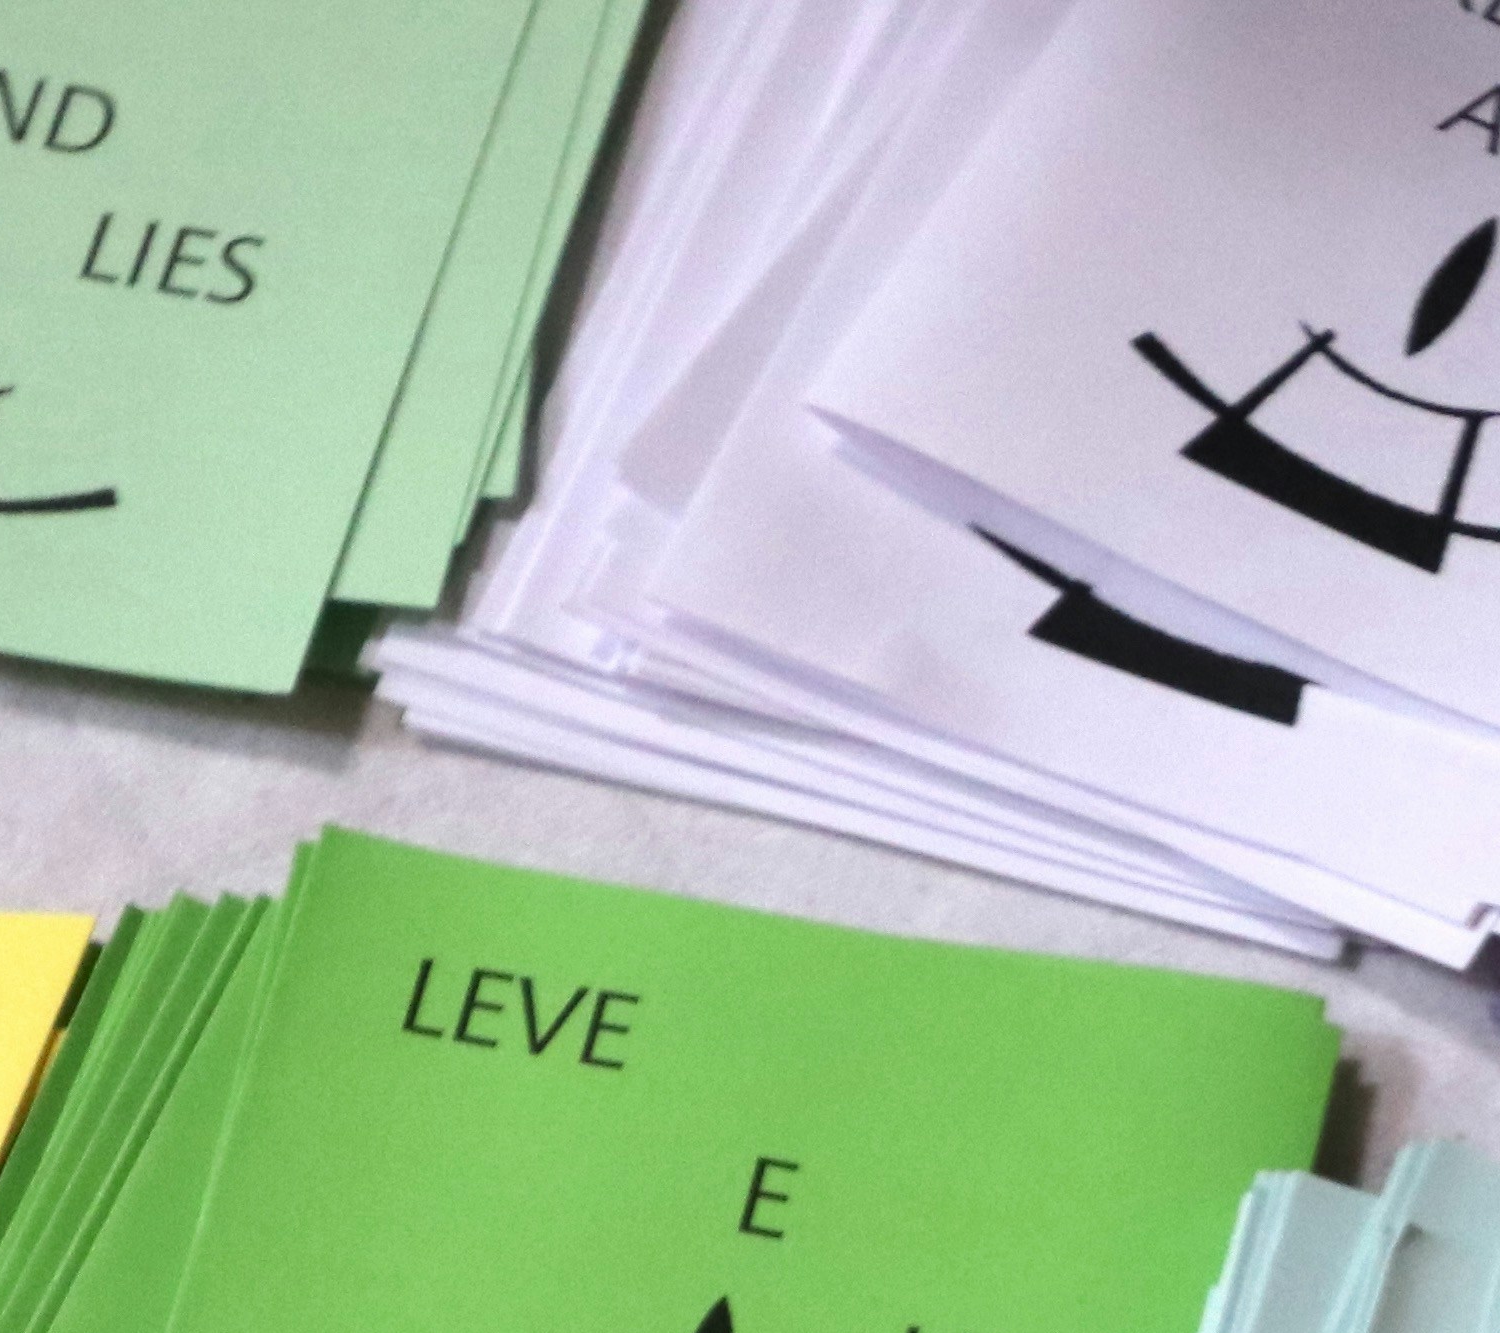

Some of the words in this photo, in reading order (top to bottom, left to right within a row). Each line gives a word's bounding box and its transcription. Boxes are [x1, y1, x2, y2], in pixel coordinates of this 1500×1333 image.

[81, 213, 263, 304] LIES
[402, 958, 639, 1070] LEVE
[739, 1157, 798, 1239] E
